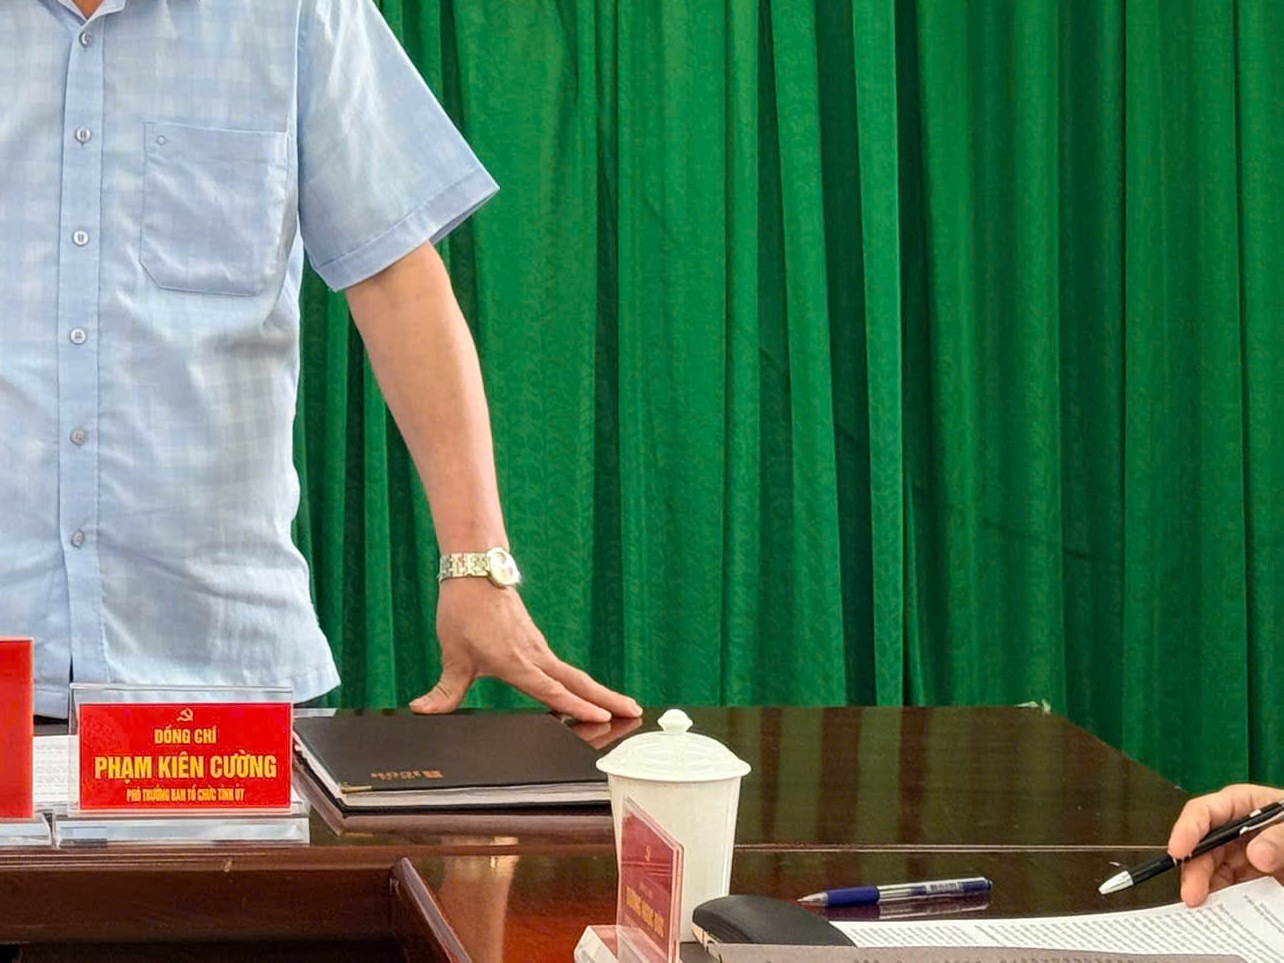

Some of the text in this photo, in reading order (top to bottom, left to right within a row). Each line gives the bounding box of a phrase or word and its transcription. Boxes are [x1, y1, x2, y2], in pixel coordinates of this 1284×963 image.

[194, 725, 217, 744] CHÍ
[94, 756, 152, 784] PHẠM
[158, 751, 204, 779] KIÊN
[210, 749, 277, 779] CƯỜNG
